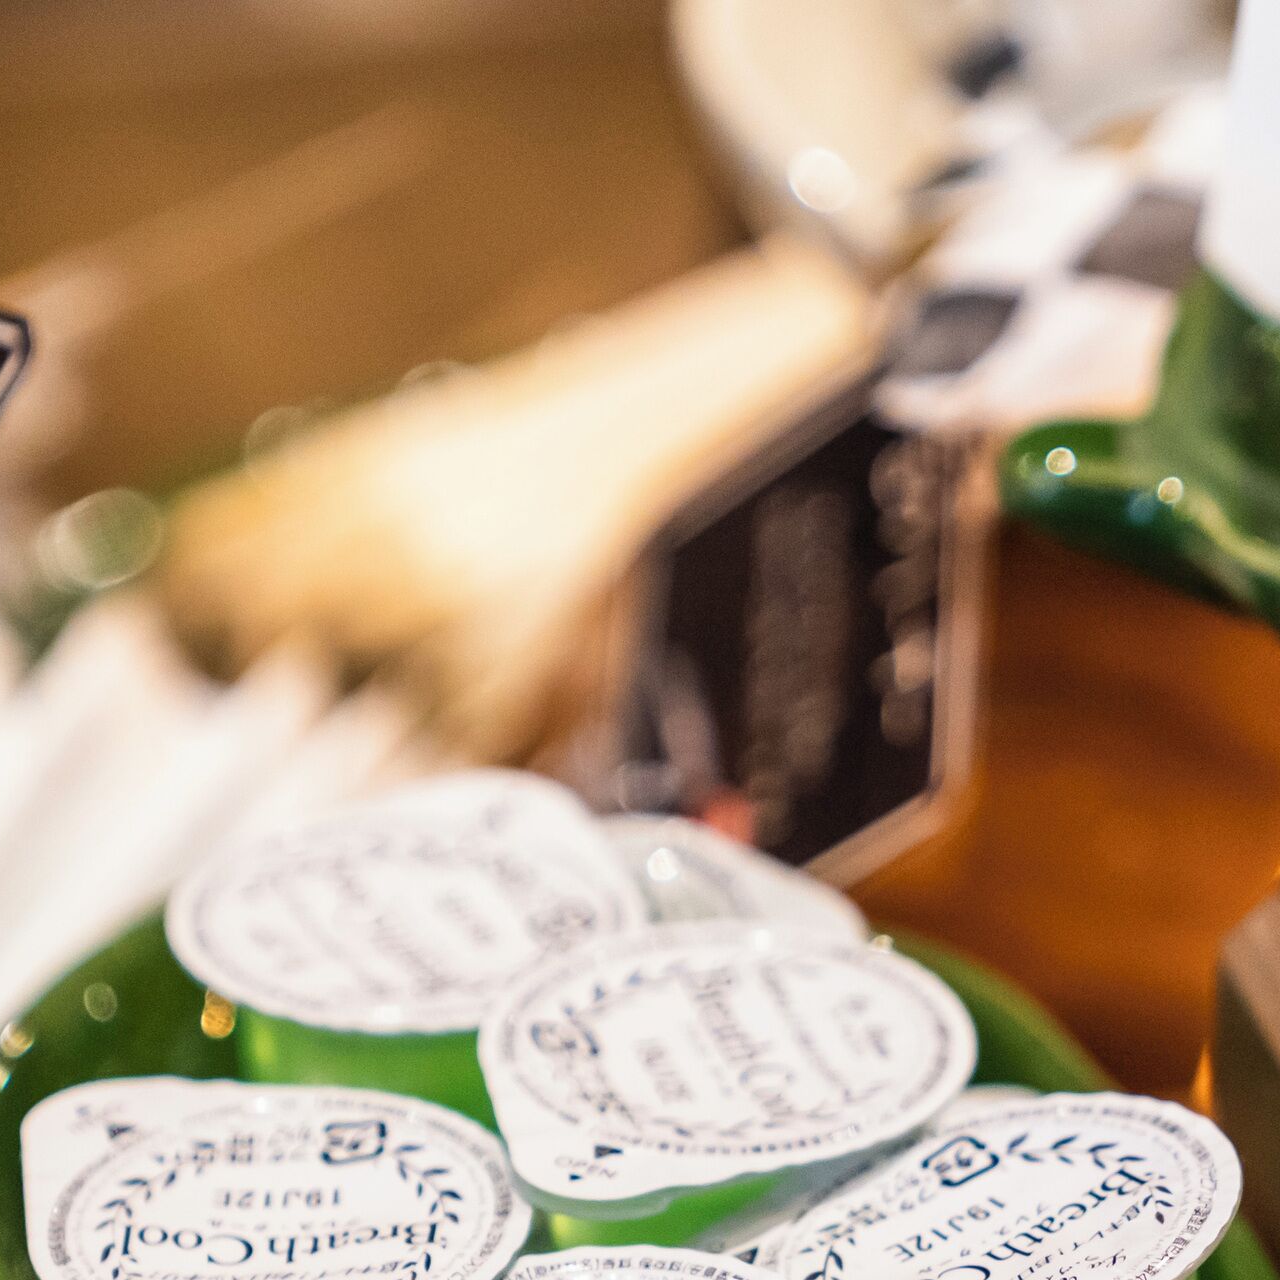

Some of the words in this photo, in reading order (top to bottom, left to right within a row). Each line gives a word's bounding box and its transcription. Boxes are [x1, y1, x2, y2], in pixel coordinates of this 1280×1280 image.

[884, 1197, 1005, 1262] 19J12E
[982, 1167, 1148, 1262] Breath
[121, 1223, 254, 1266] Cool
[268, 1221, 440, 1264] Breath
